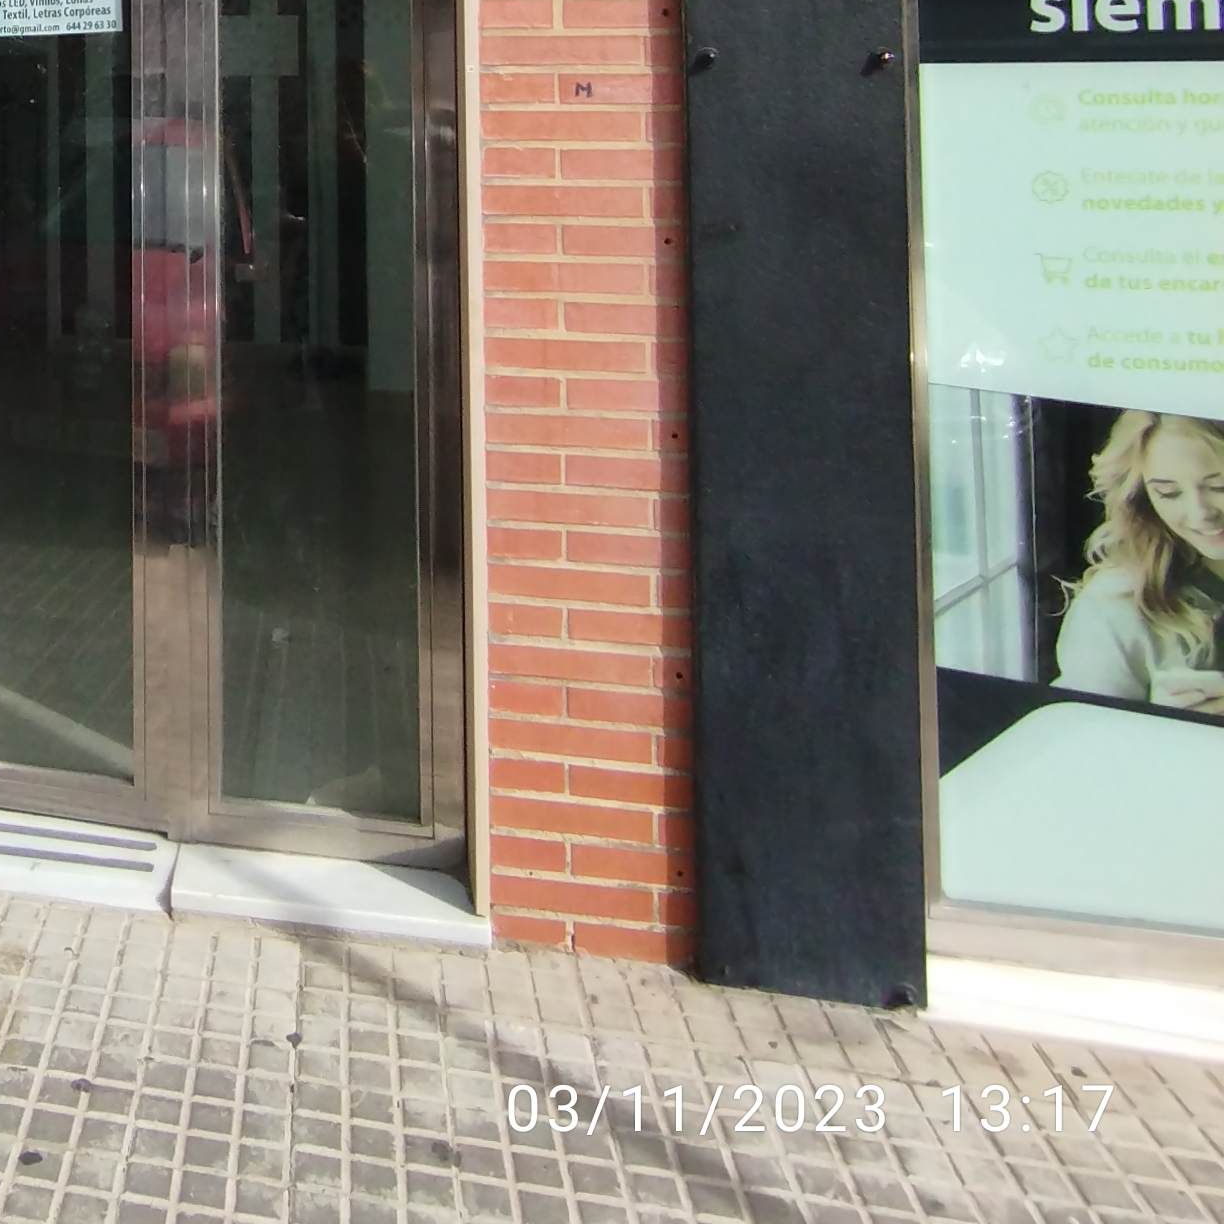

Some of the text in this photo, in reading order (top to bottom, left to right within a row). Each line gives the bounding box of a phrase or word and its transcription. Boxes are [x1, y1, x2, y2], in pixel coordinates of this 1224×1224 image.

[2, 8, 31, 20] Textil,
[33, 7, 62, 19] Letras
[63, 6, 112, 19] Corpóreas
[1078, 88, 1176, 106] Consulta
[1081, 194, 1206, 212] novedades
[1082, 246, 1176, 265] Consulta
[1084, 273, 1113, 290] de
[1119, 275, 1153, 291] tus
[1087, 352, 1116, 370] de
